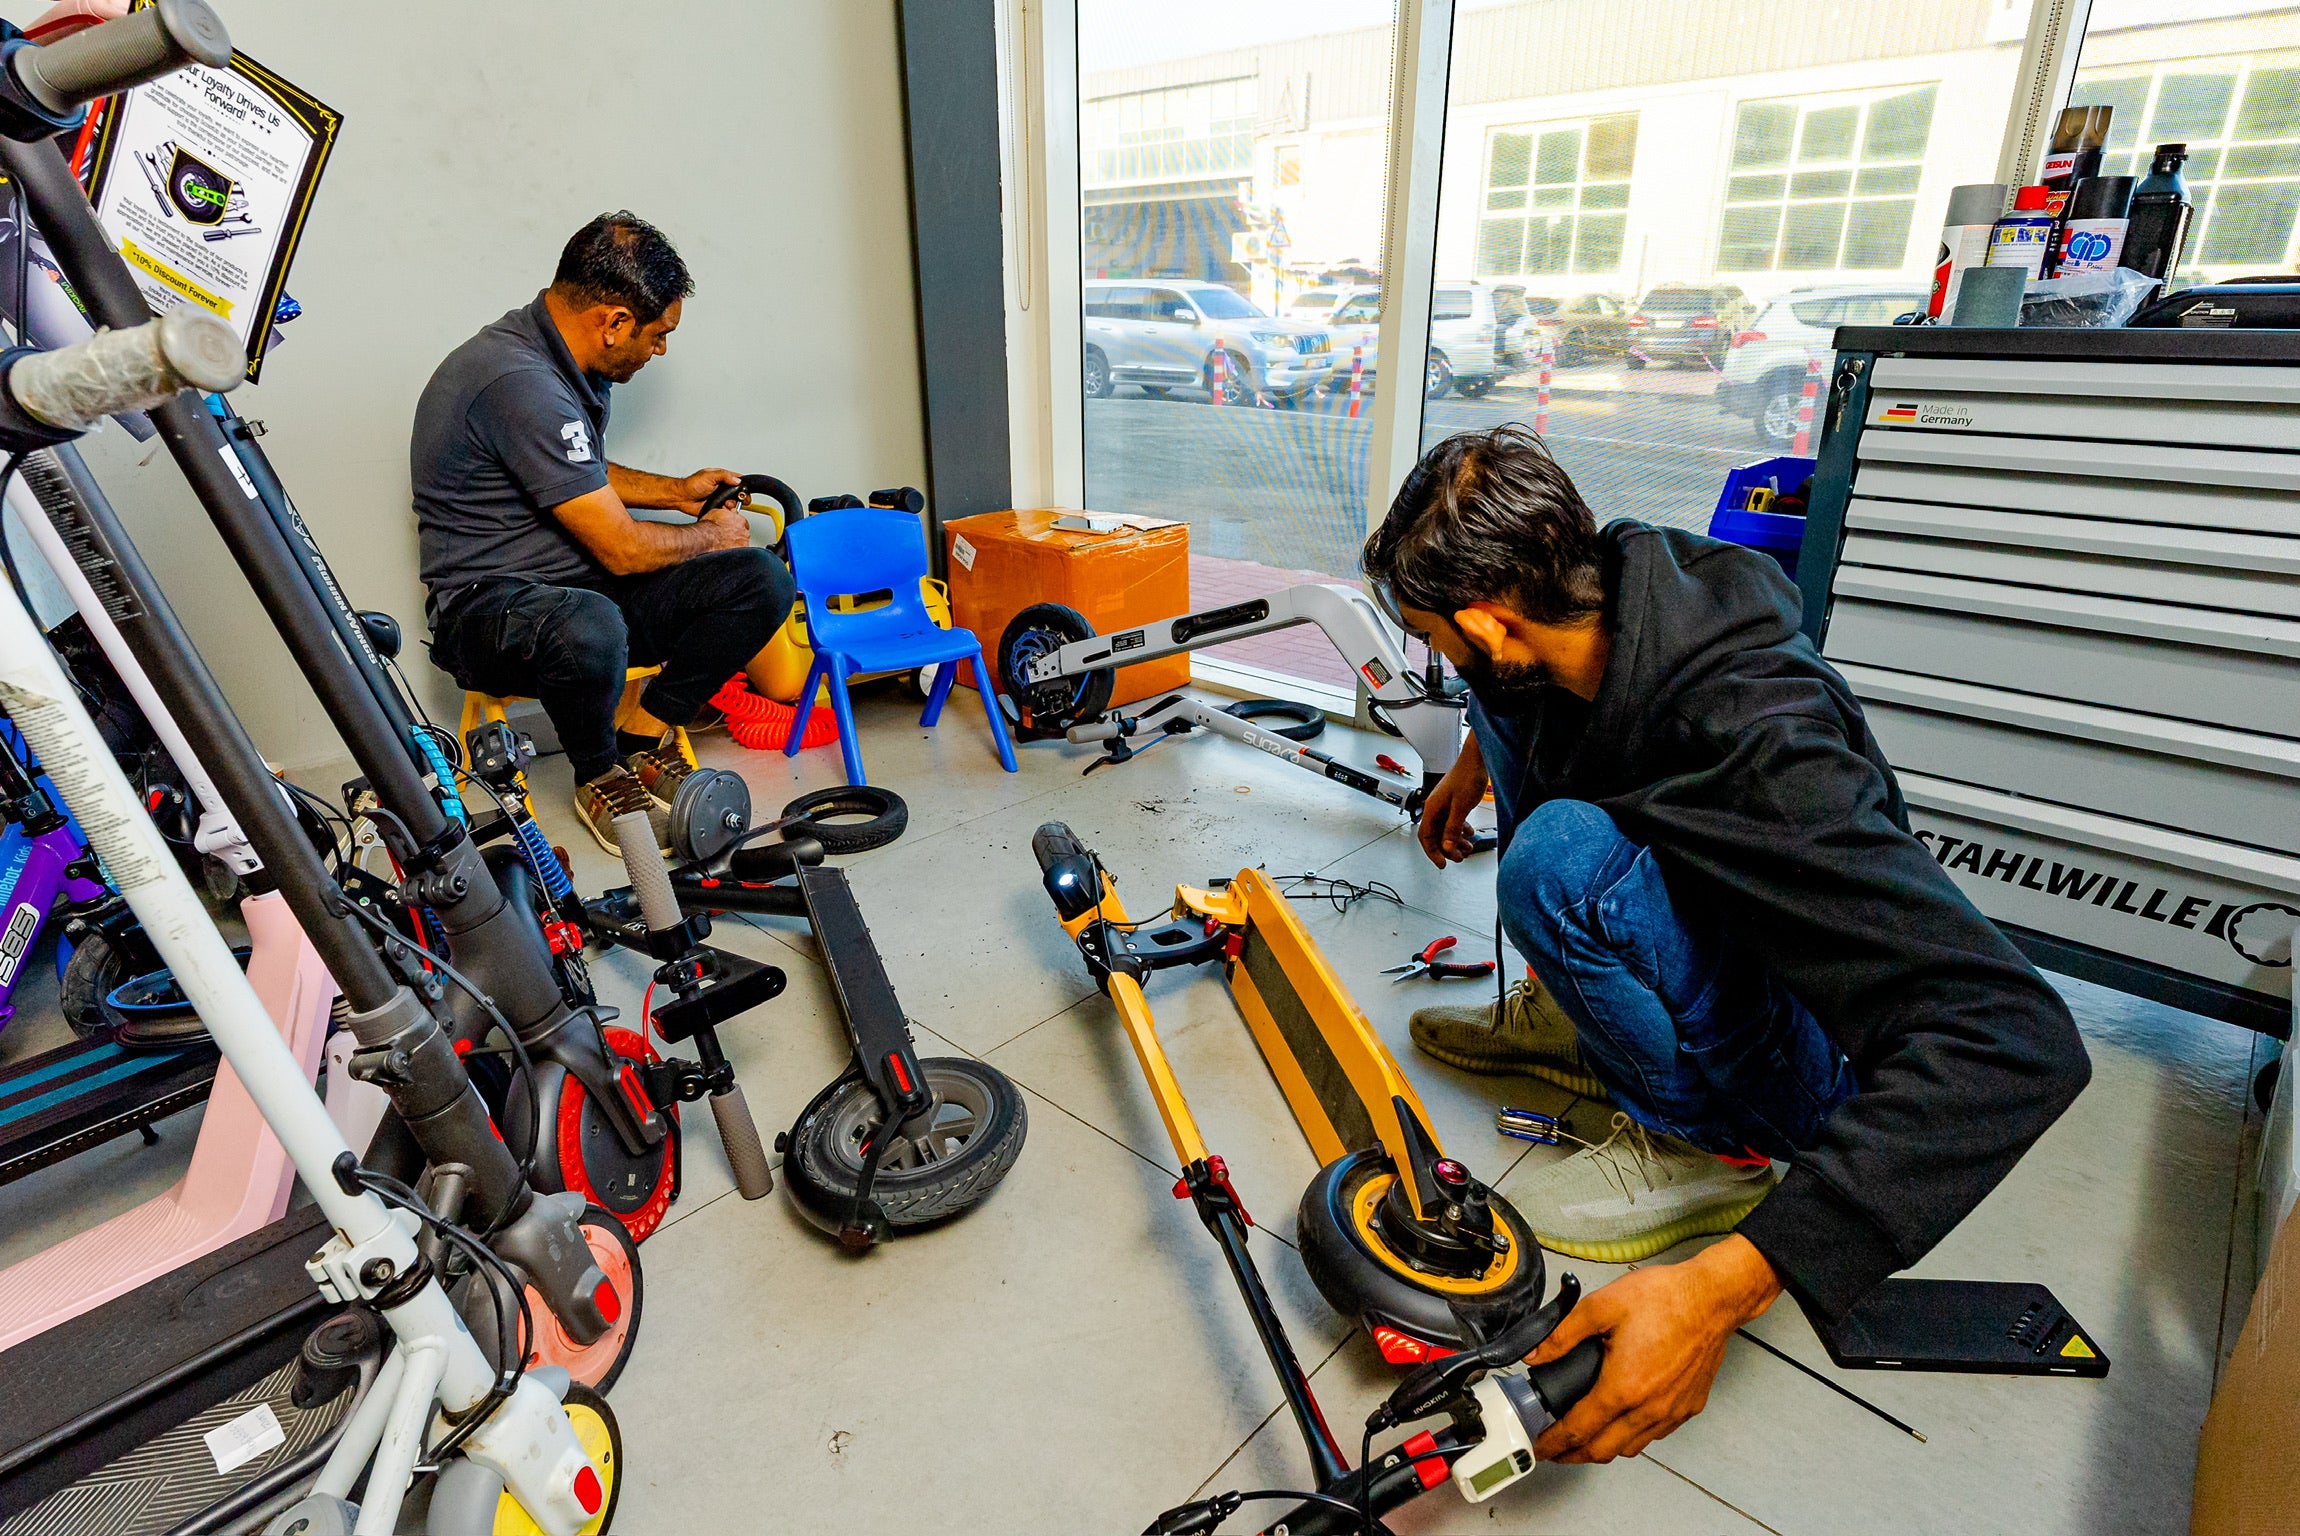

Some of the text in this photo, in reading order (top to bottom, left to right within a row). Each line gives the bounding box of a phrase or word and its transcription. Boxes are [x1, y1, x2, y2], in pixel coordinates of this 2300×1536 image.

[201, 71, 235, 99] Loyalty
[236, 93, 266, 119] Drives
[268, 112, 281, 128] Us
[204, 88, 247, 120] Forward!
[153, 264, 188, 291] Discount
[188, 286, 218, 310] Forever
[1920, 414, 1973, 426] Germany
[1923, 404, 1968, 417] Made in
[560, 420, 591, 462] 3
[12, 844, 33, 864] Kids
[1913, 830, 2212, 932] STAHLWILLE
[1413, 1390, 1449, 1415] INOKIM
